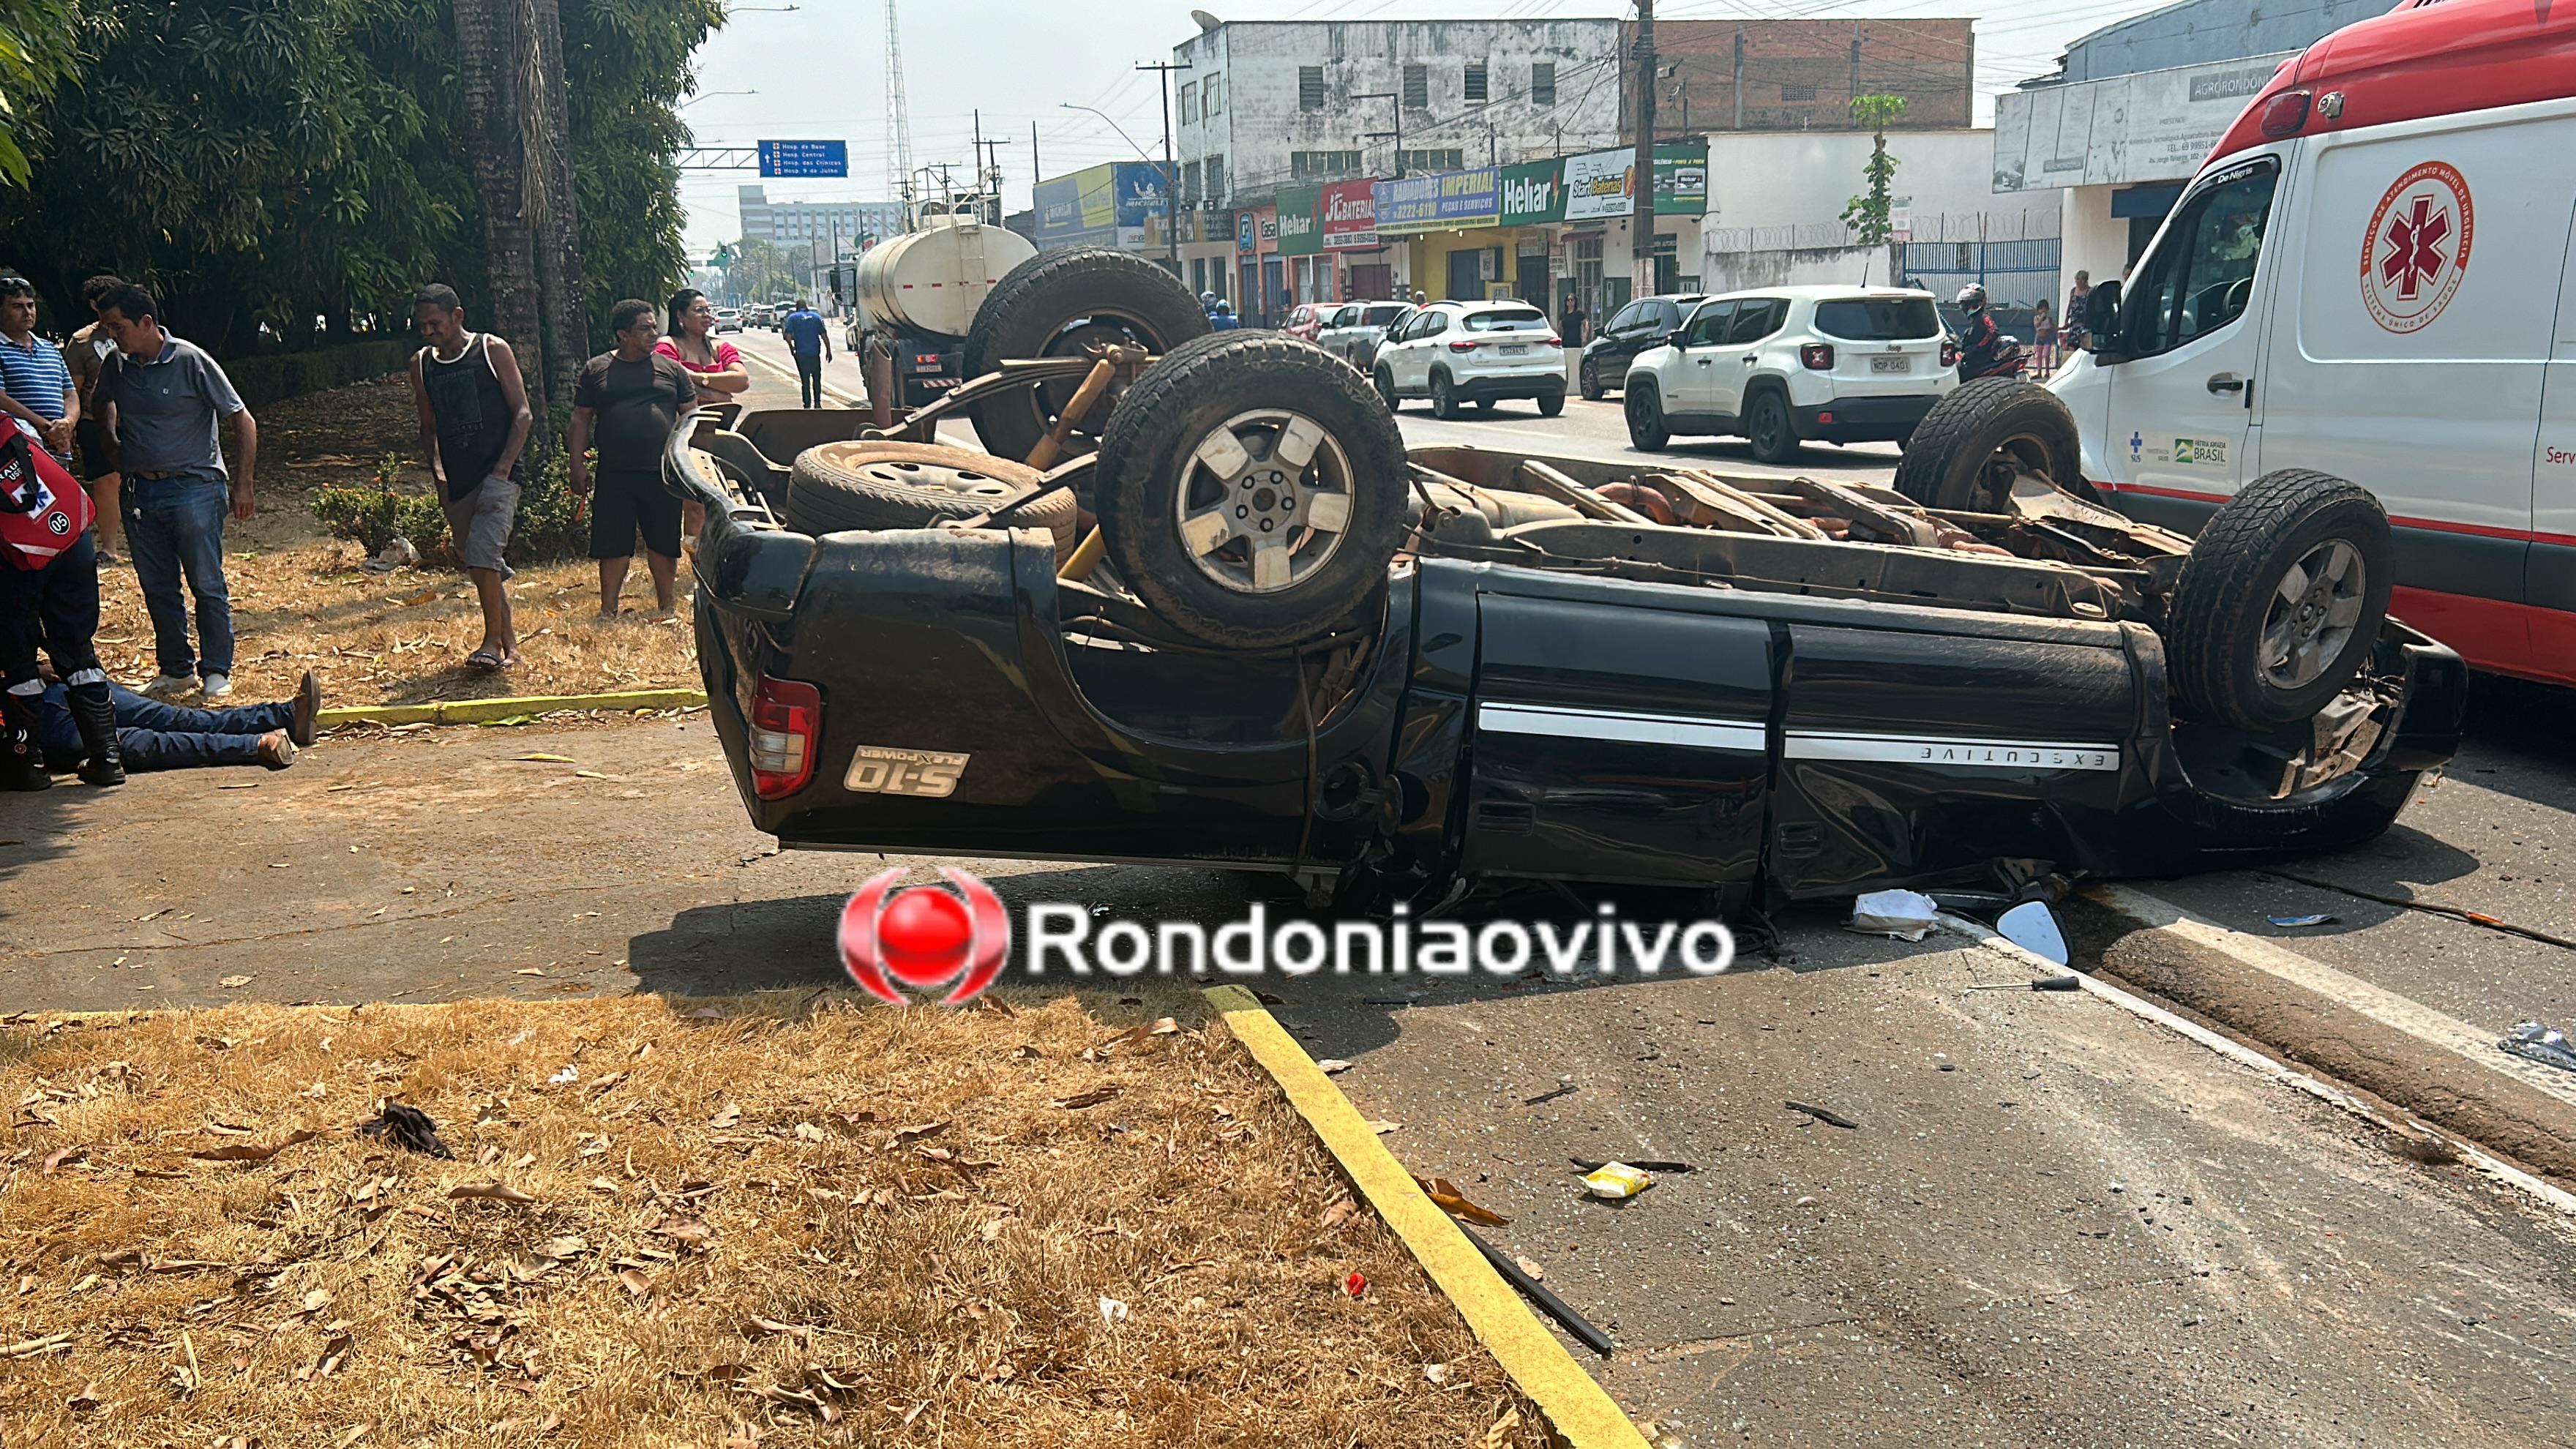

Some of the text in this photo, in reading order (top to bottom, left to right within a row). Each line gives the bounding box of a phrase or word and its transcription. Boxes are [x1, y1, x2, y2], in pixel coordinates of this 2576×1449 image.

[2195, 75, 2269, 95] AGRORONDONI
[2218, 167, 2253, 184] De Nigris
[1393, 171, 1494, 202] RADIADORES IMPERIAL
[1505, 176, 1551, 214] Heliar
[1573, 178, 1622, 198] Start Baterias
[1441, 201, 1459, 213] PEÇAS
[1464, 198, 1493, 211] SERVIÇOS
[1279, 214, 1311, 236] Heliar
[2363, 167, 2471, 265] SERVIÇO DE ATENDIMENTO MÓVEL DE URGÊNCIA
[2365, 279, 2457, 329] SISTEMA ÚNICO DE SAÚDE
[2195, 439, 2225, 449] PÁTRIA AMADA
[2130, 454, 2141, 463] SUS
[2195, 448, 2225, 462] BRASIL
[0, 460, 20, 481] RAU
[51, 514, 67, 531] 05
[1921, 746, 2105, 766] EXECUTIVE
[847, 760, 962, 795] S-10
